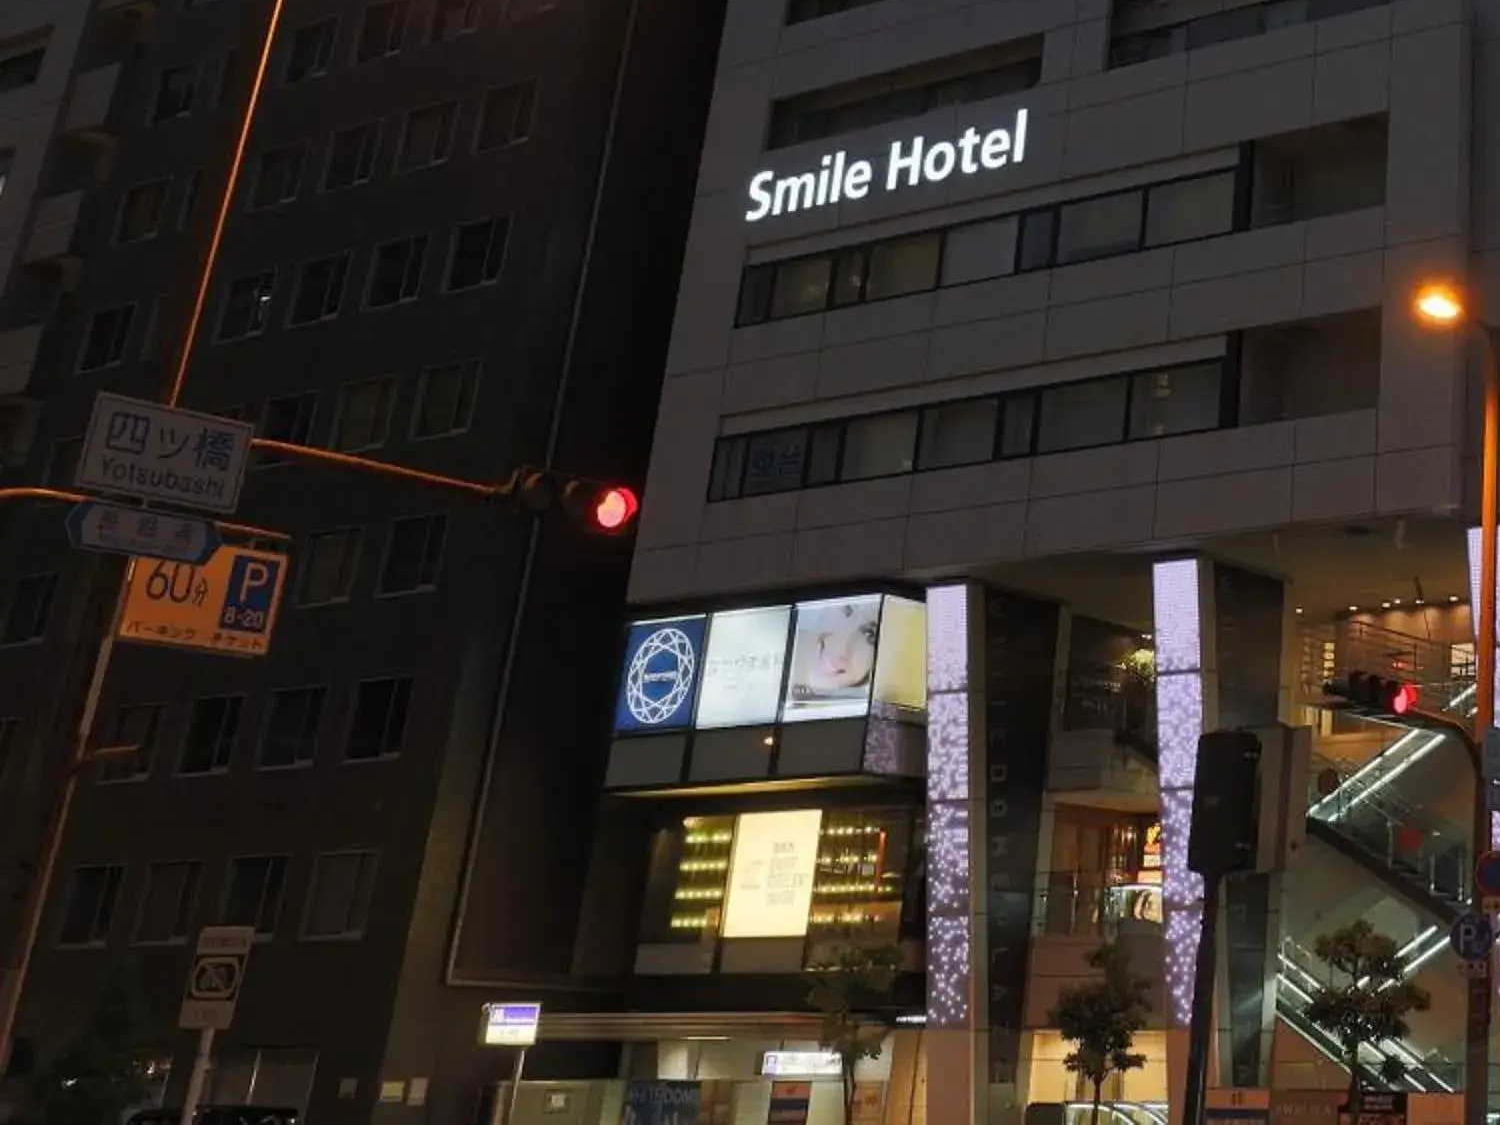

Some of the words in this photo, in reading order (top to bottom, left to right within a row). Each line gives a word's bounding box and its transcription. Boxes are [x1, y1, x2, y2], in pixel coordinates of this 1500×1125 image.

[745, 151, 872, 222] Smile
[886, 108, 1028, 192] Hotel
[106, 411, 234, 472] 四ツ橋
[102, 454, 225, 499] Yotsubashi
[239, 562, 269, 603] P
